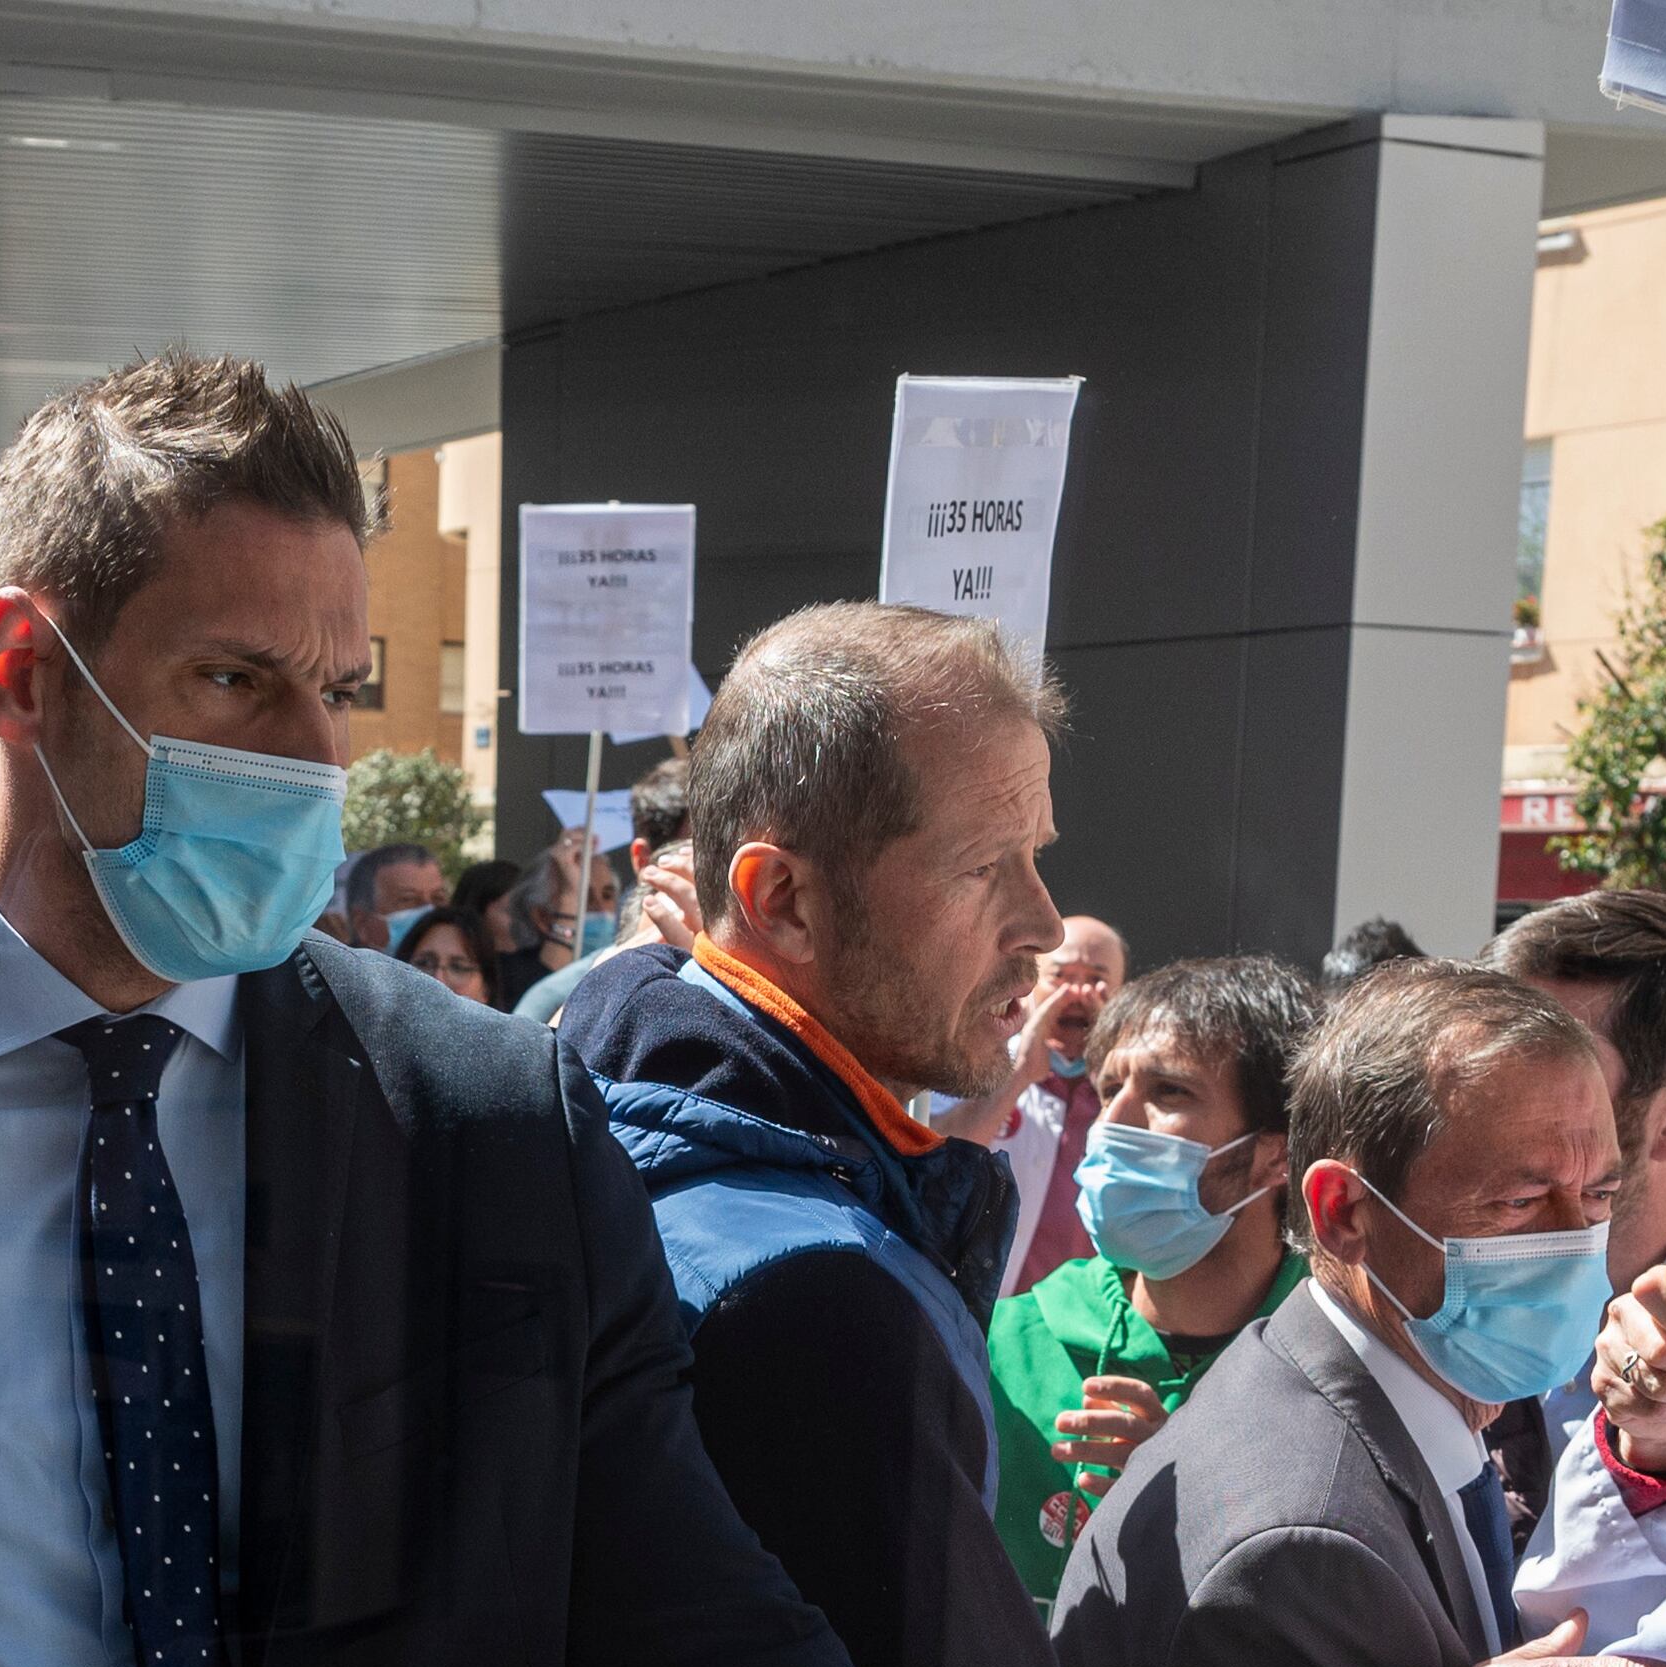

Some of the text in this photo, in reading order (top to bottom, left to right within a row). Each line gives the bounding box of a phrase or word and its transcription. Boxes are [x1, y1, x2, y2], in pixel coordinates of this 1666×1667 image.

[927, 499, 1024, 538] ¡¡¡35 HORAS
[600, 549, 657, 563] HORAS
[953, 566, 993, 601] YA!!!
[598, 660, 655, 674] HORAS
